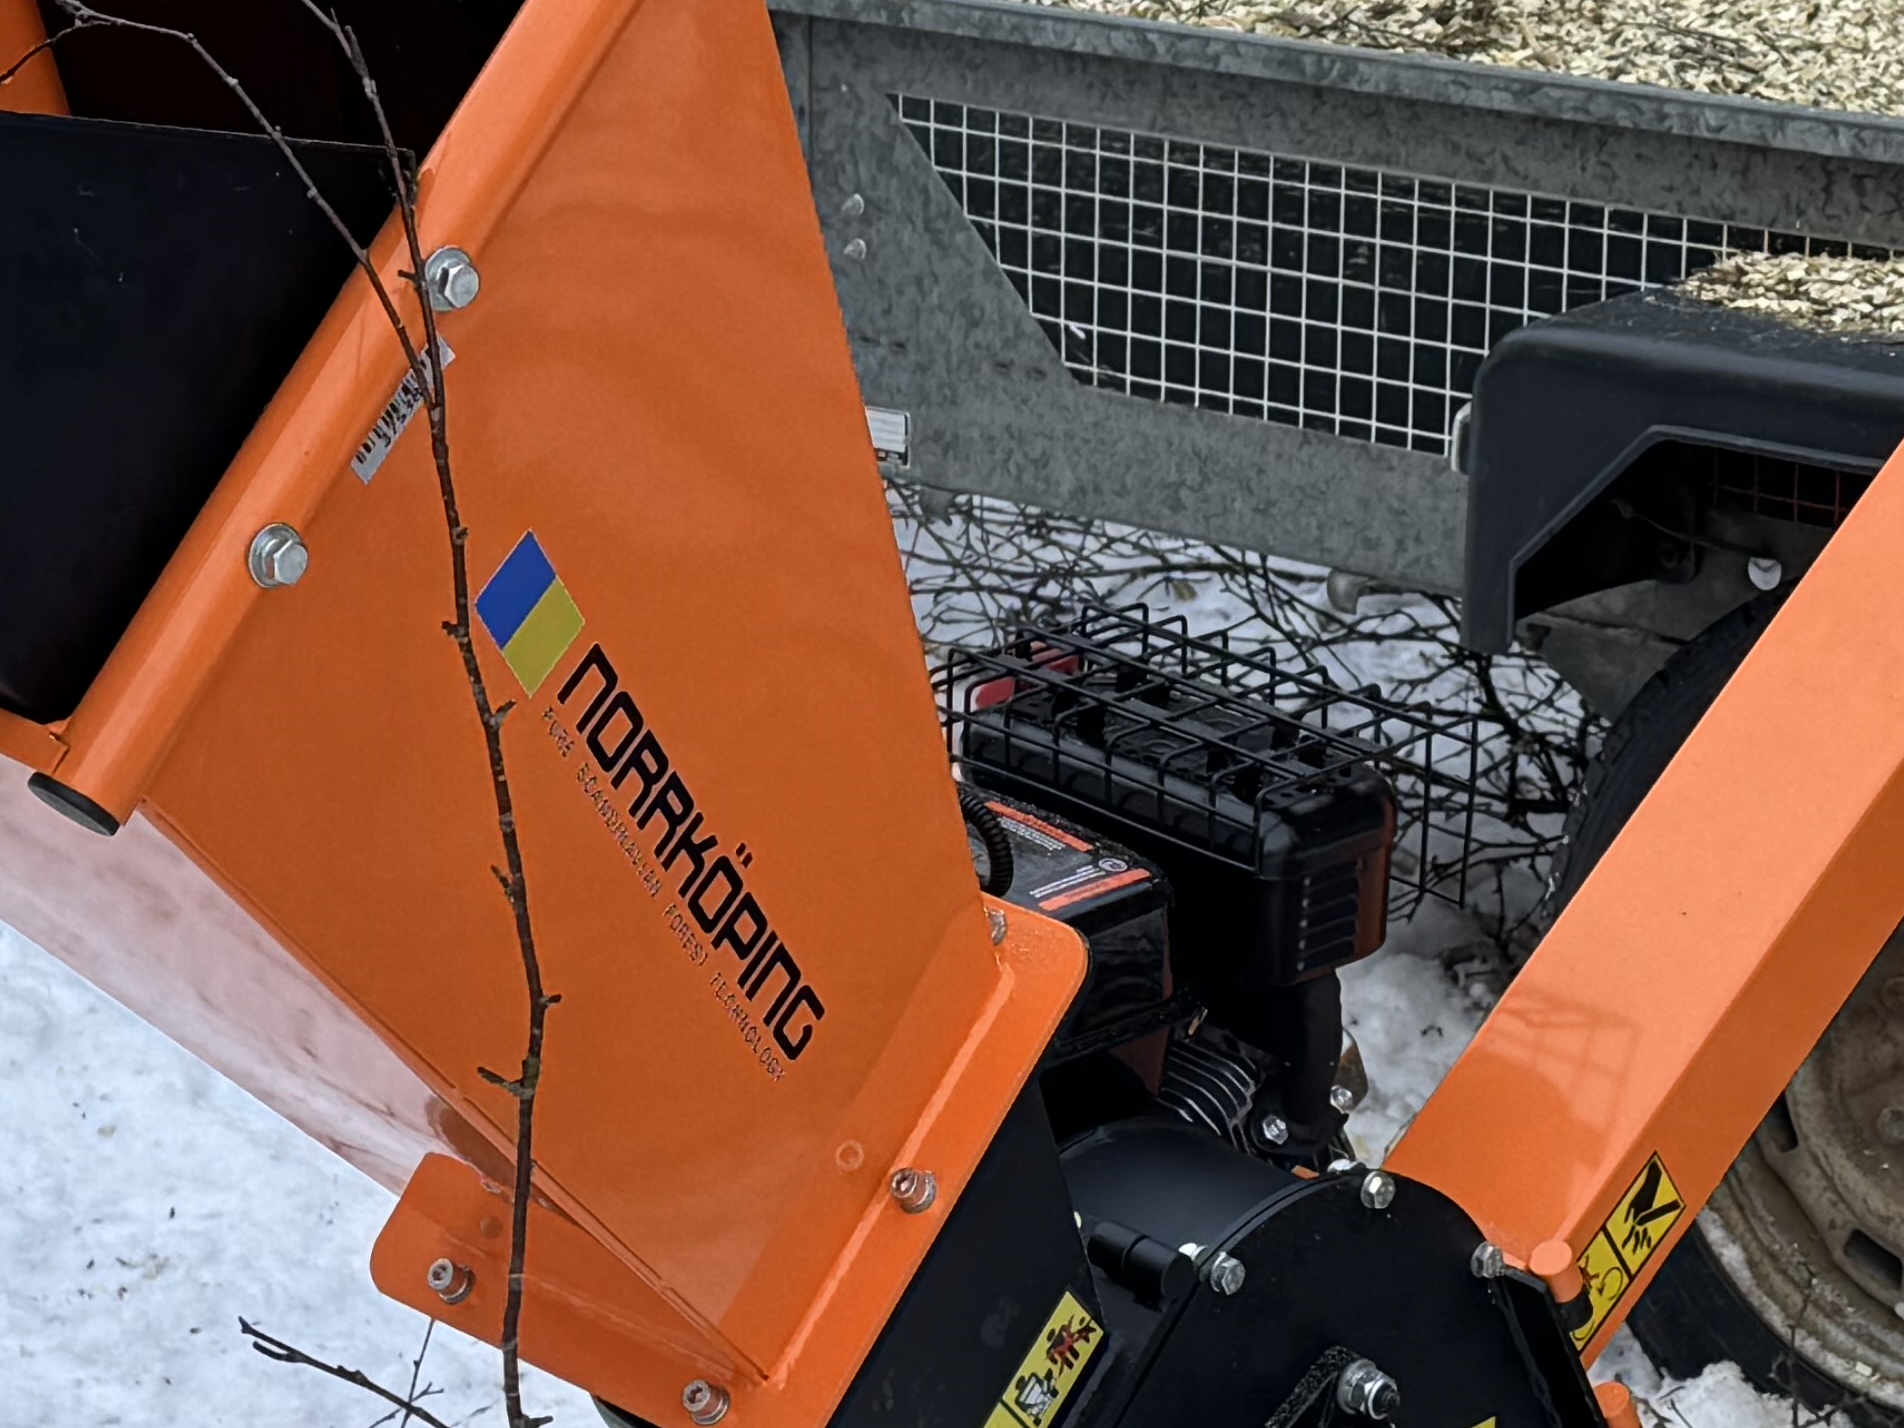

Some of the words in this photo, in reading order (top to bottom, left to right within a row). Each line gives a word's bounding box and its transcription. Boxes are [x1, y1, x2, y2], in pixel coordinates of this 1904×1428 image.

[557, 643, 825, 1061] NORRKÖPING
[576, 763, 664, 899] SCANDINAVIAN
[662, 903, 709, 968] FOREST
[709, 972, 786, 1084] TECHNOLOGY
